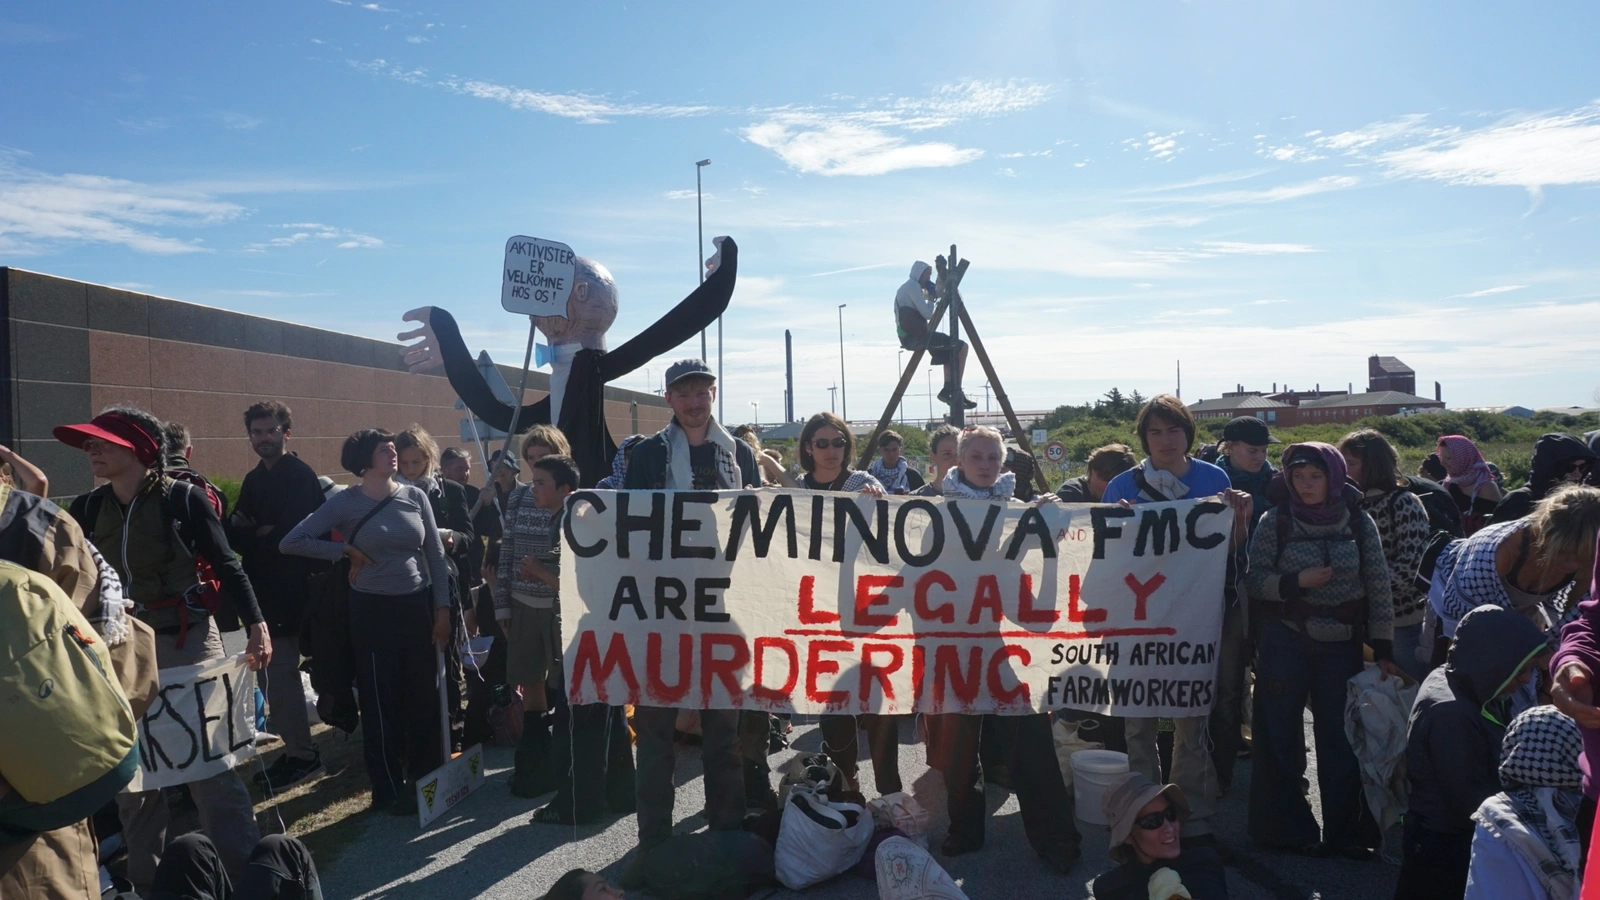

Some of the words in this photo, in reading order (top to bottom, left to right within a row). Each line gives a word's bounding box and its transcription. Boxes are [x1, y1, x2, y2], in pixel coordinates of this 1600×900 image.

[509, 241, 574, 265] AKTIVISTER
[507, 269, 564, 290] VELKOMNE
[529, 260, 545, 275] ER
[511, 286, 530, 300] HOS
[1049, 447, 1062, 455] 50
[564, 491, 1057, 567] CHEMINOVA
[1056, 528, 1087, 541] AND
[1090, 501, 1228, 560] FMC
[609, 576, 731, 622] ARE
[797, 569, 1167, 626] LEGALLY
[1051, 641, 1120, 666] SOUTH
[1129, 642, 1216, 666] AFRICAN
[569, 629, 1032, 714] MURDERING
[1048, 676, 1212, 707] FARMWORKERS
